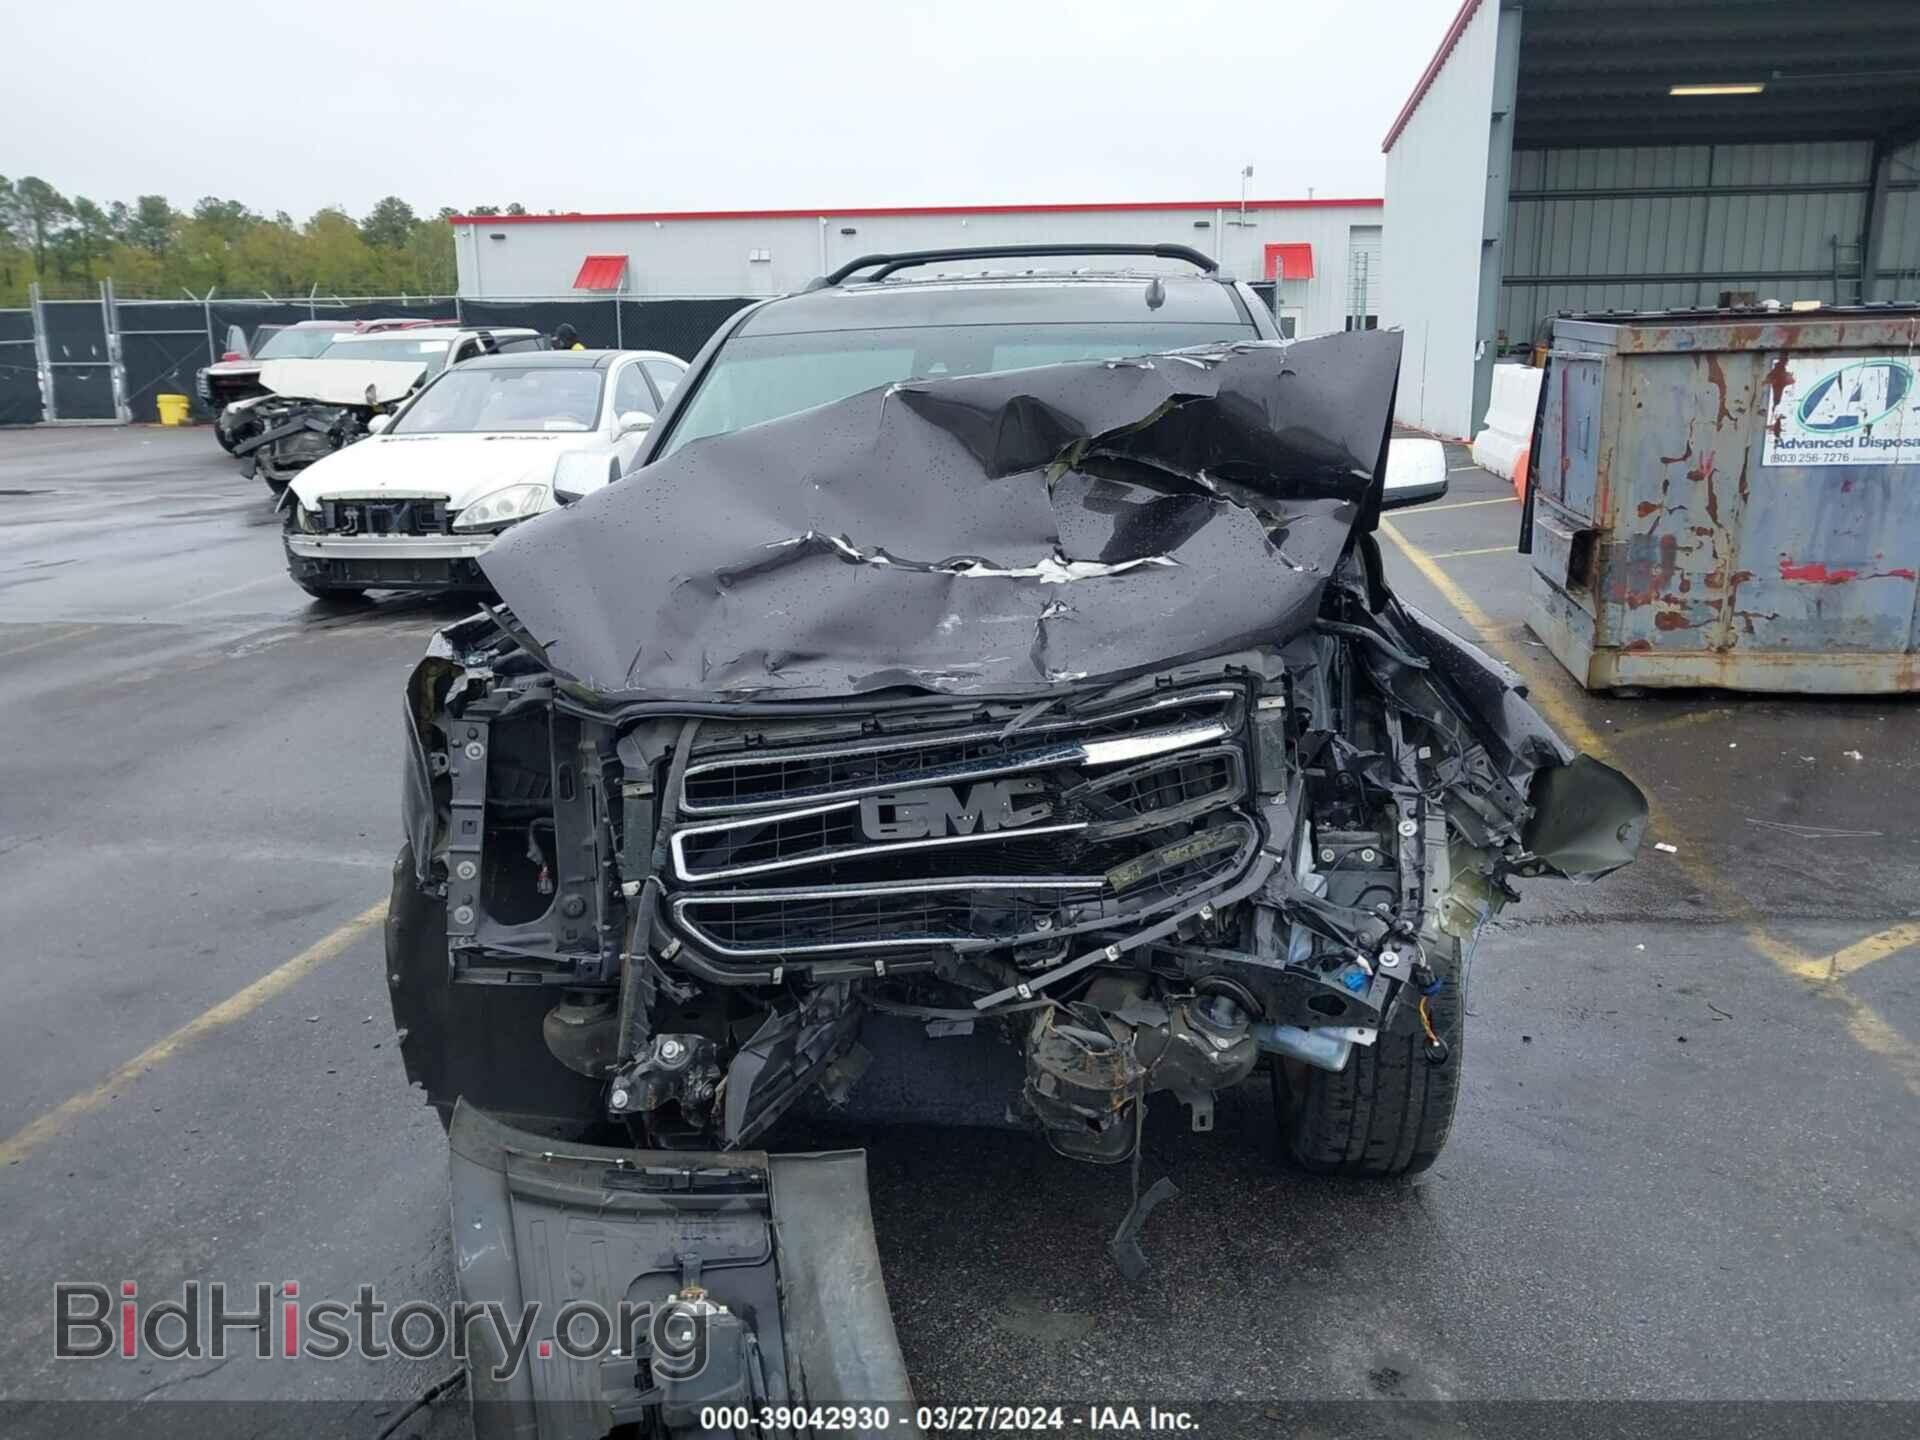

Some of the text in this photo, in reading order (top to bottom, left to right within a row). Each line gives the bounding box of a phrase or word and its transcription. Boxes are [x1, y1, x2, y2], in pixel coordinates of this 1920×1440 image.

[1775, 436, 1855, 449] Advanced
[1770, 453, 1797, 464] (803)
[1798, 452, 1850, 463] 256-7276
[860, 778, 1053, 840] GMC
